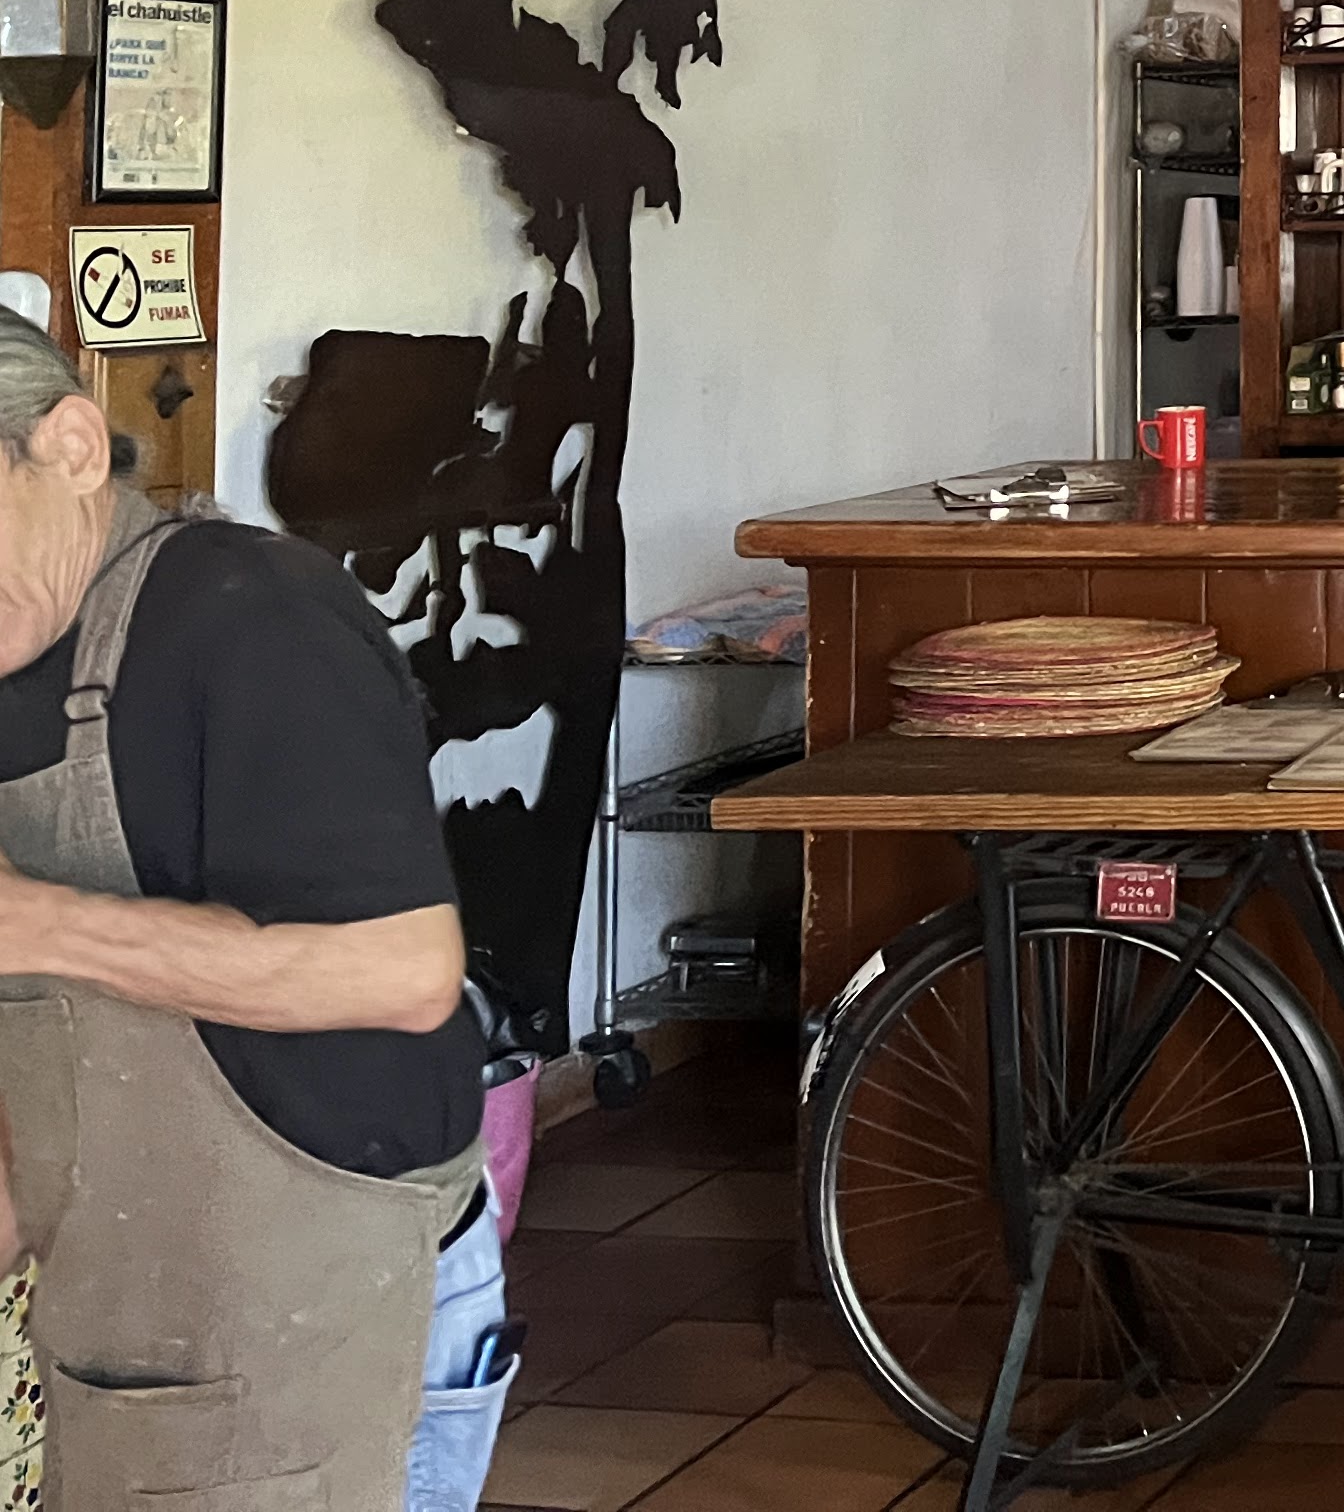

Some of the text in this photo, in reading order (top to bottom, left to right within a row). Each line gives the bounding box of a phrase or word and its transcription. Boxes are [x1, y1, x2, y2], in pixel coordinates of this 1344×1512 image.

[107, 0, 212, 24] el chahuistle
[151, 249, 175, 264] SE
[144, 278, 186, 293] PROHIBE
[149, 305, 190, 321] FUMAR
